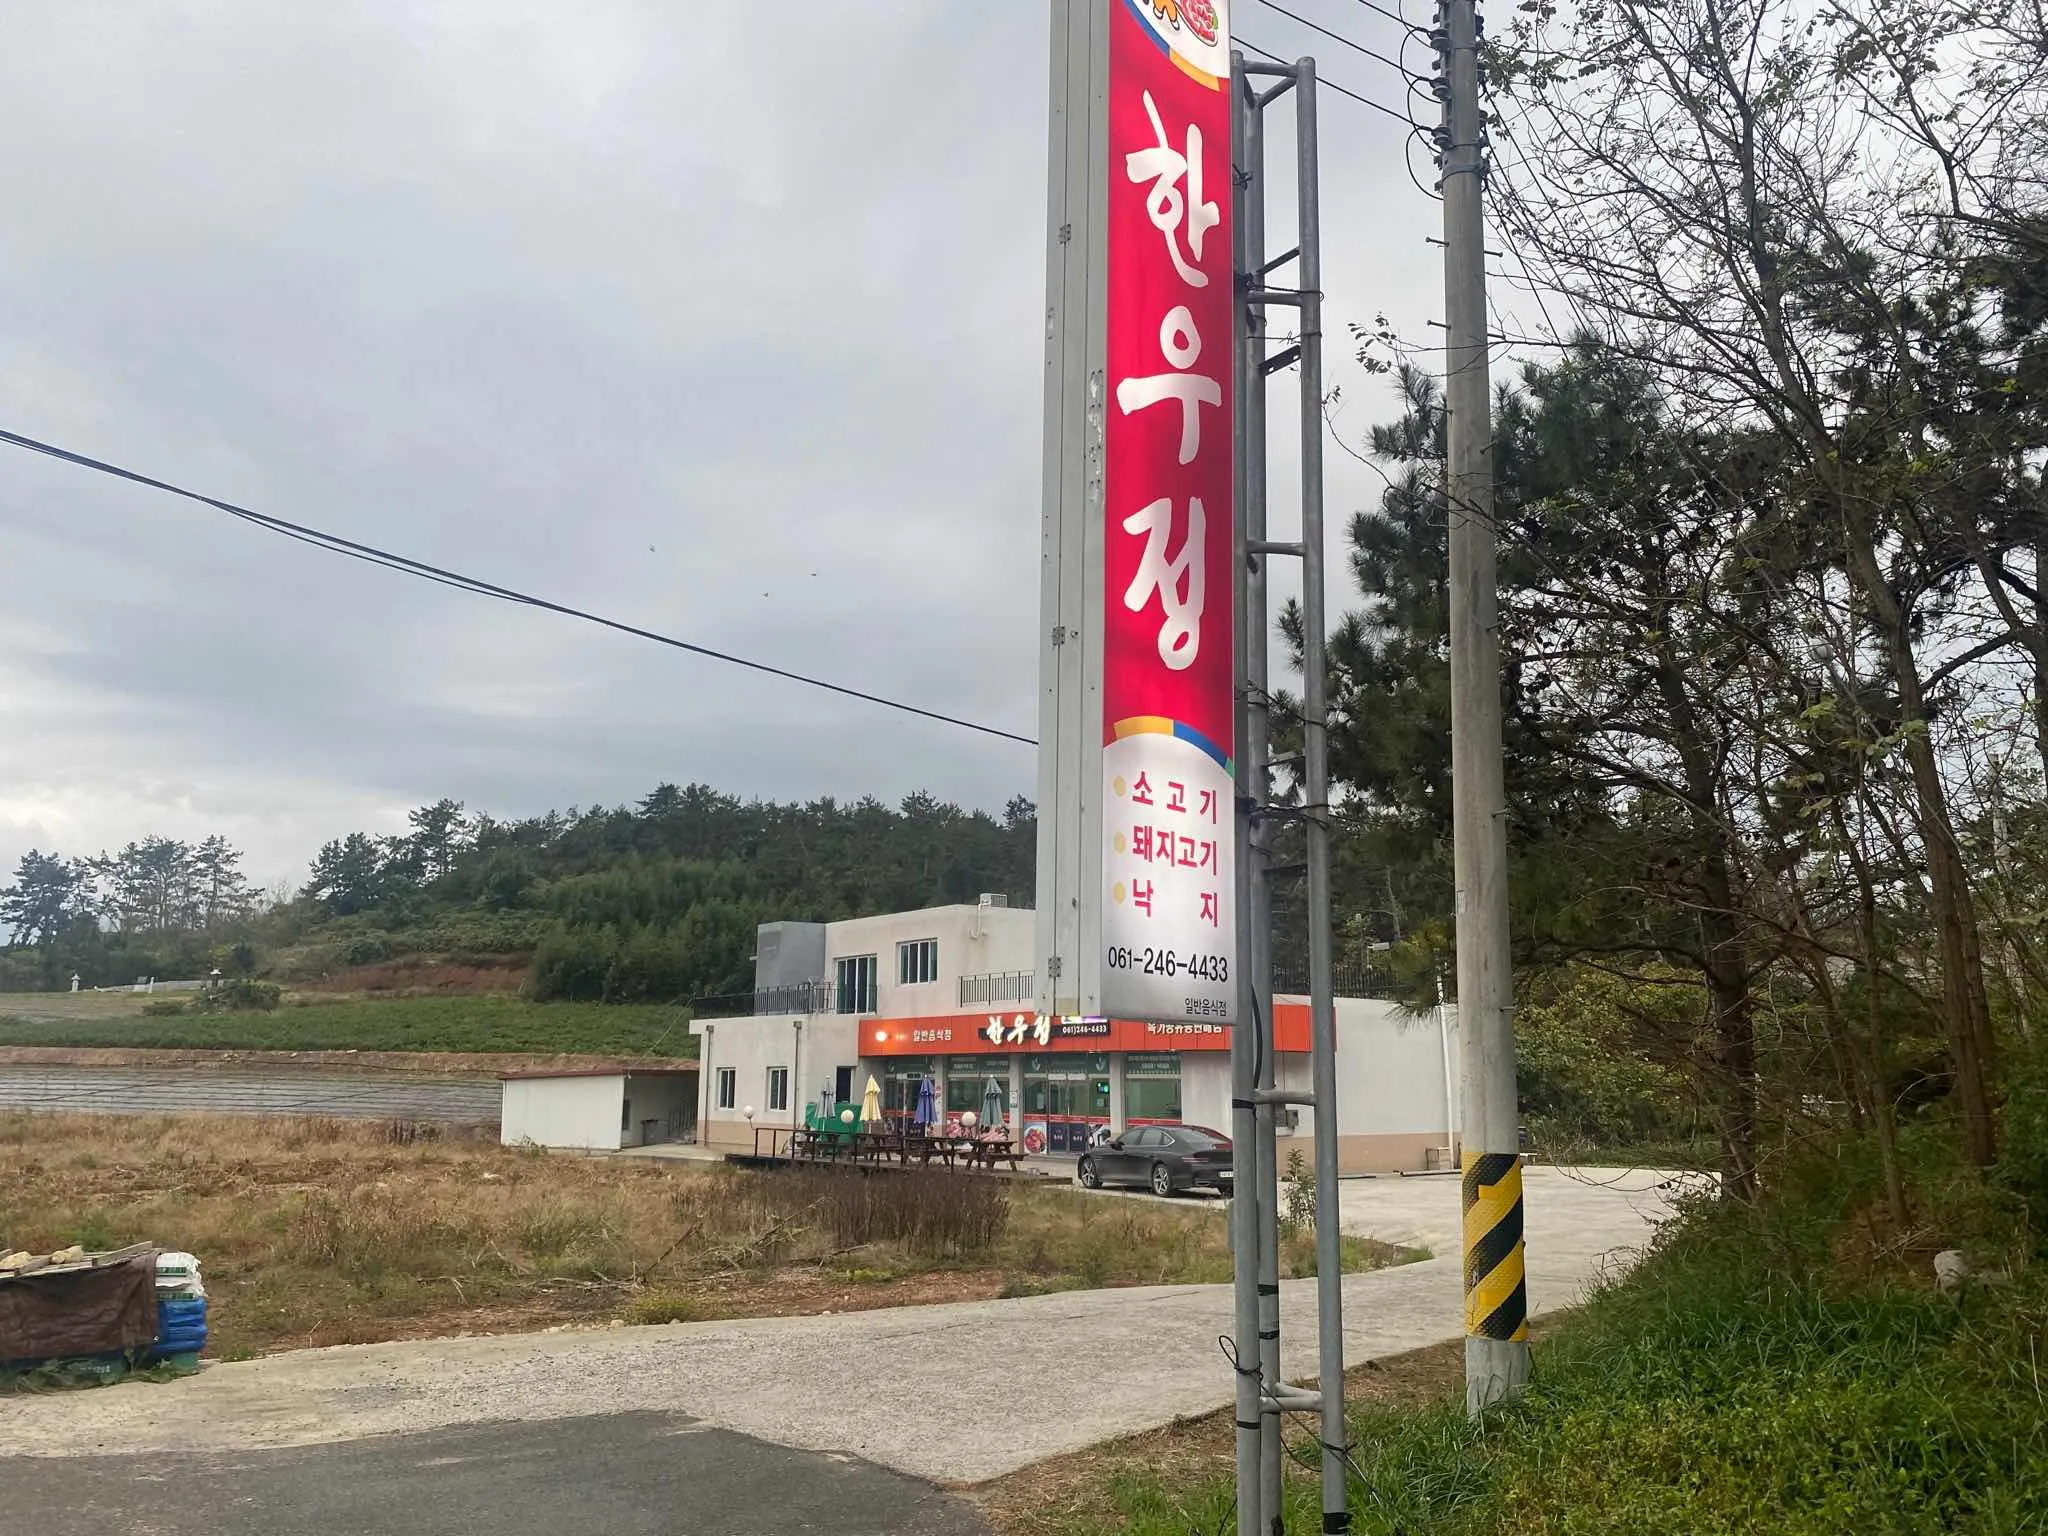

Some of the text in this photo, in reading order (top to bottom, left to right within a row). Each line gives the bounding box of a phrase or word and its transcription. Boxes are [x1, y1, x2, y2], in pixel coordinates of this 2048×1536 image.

[1117, 89, 1222, 670] 한우정
[1132, 770, 1217, 824] 소고기
[1132, 825, 1217, 876] 돼지고기
[1108, 946, 1228, 983] 061-246-4433
[1184, 998, 1227, 1018] 일반음식점
[913, 1029, 952, 1042] 일반음식점
[986, 1014, 1051, 1046] 한우정
